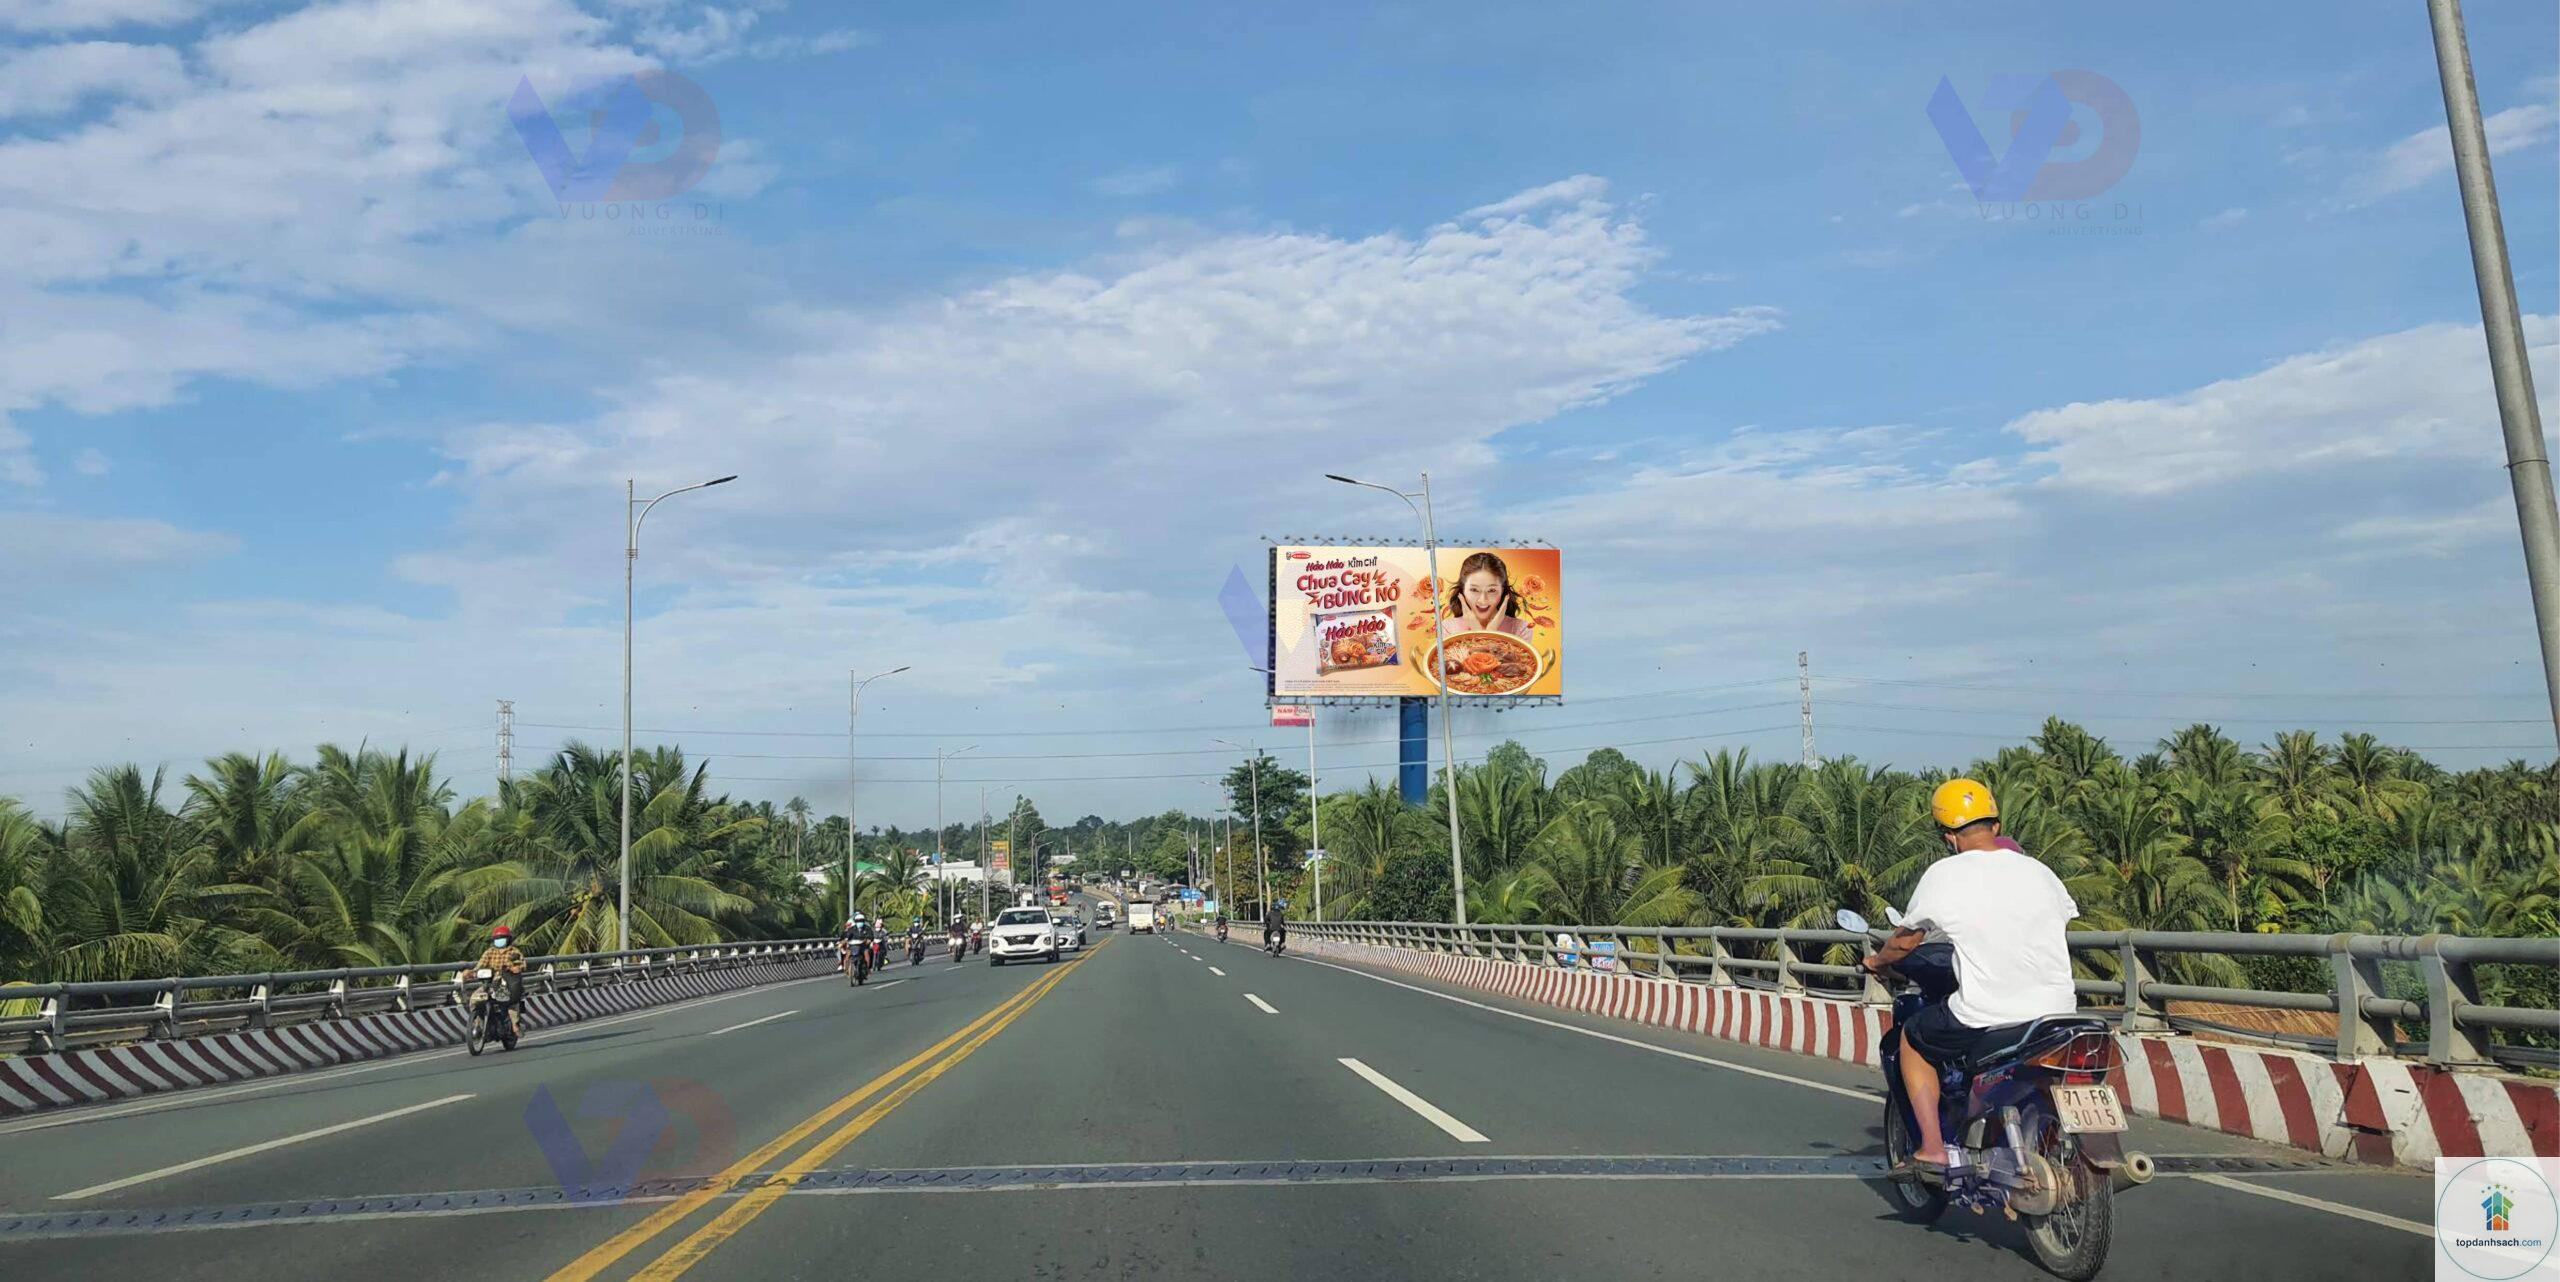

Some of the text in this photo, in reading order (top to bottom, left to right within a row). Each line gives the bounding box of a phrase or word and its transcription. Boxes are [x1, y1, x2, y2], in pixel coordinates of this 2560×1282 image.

[1297, 570, 1371, 591] Chua Cay
[1324, 578, 1401, 609] BÙNG NỔ
[2071, 1109, 2116, 1126] 3015
